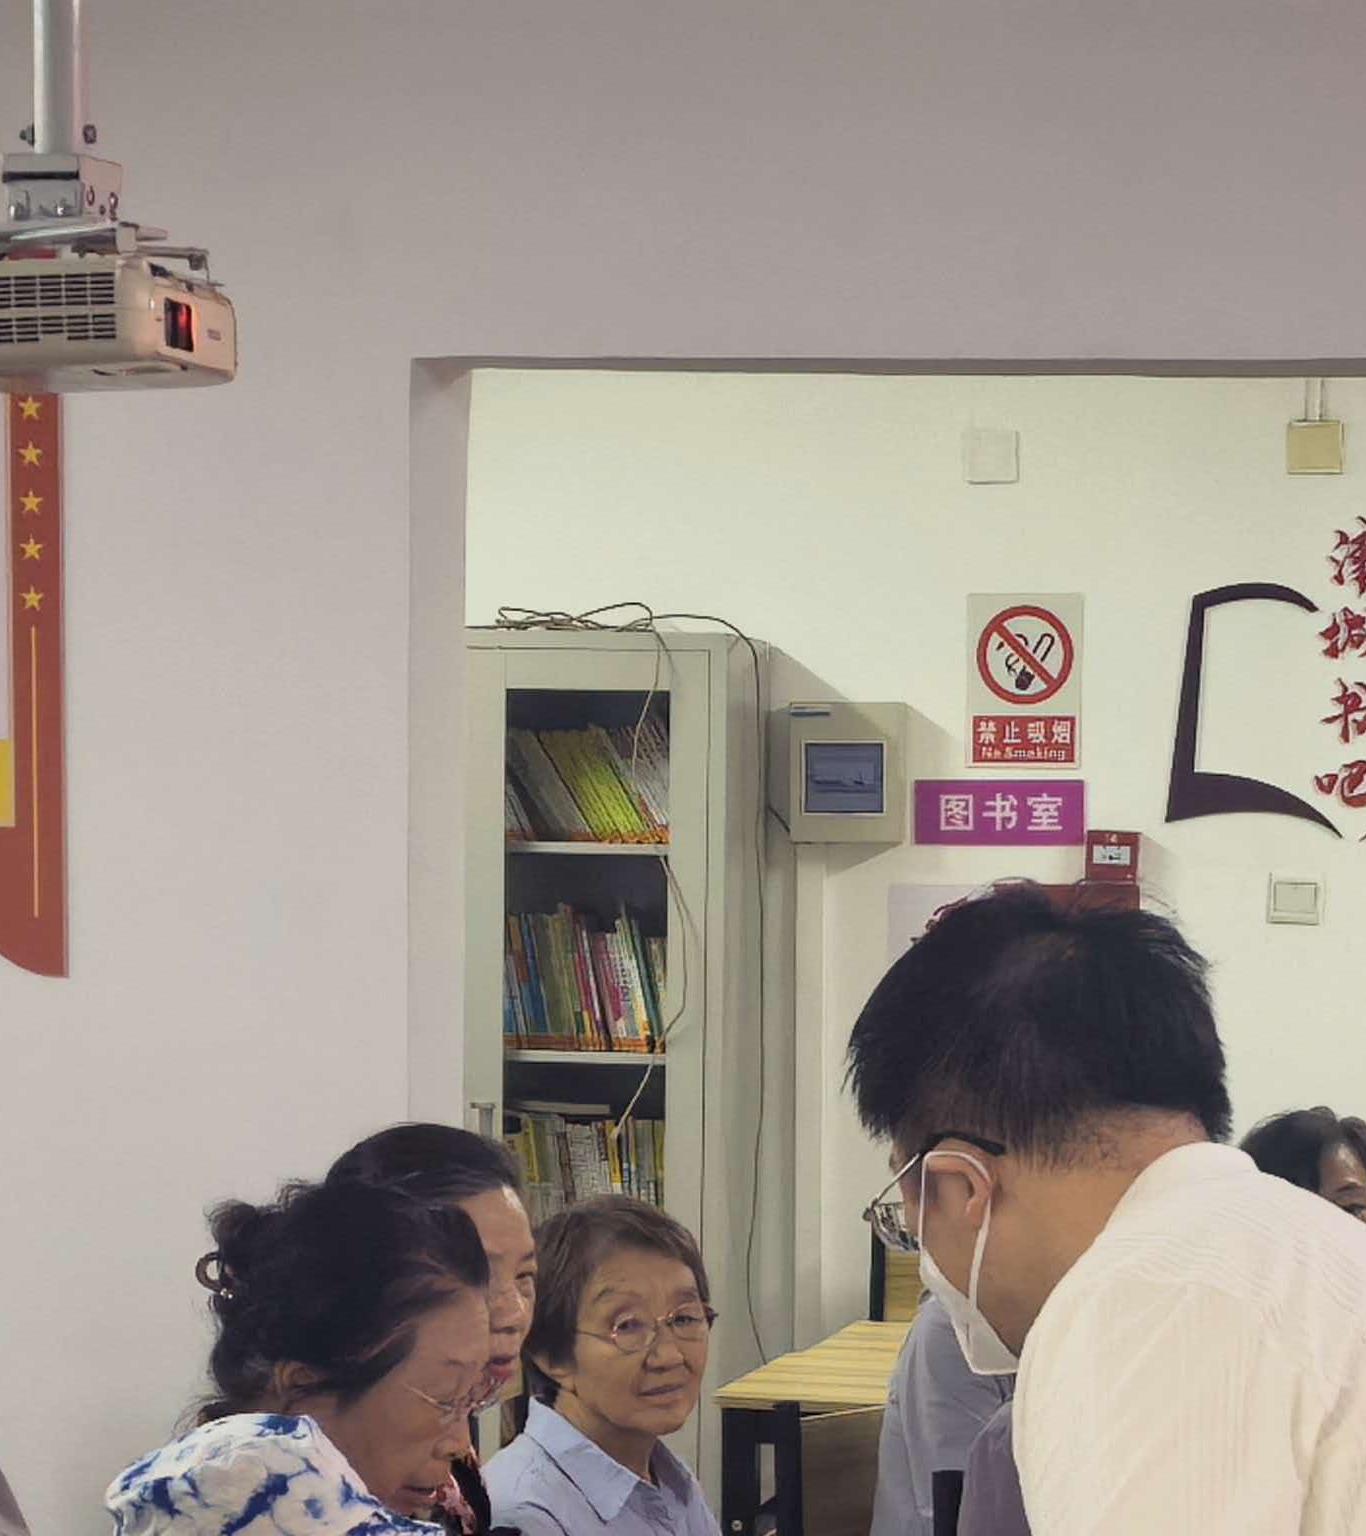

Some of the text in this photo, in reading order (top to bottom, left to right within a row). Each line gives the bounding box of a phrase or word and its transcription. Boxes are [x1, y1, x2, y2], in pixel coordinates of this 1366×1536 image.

[977, 719, 1072, 745] 禁止吸烟
[1004, 746, 1067, 762] Smoking
[939, 792, 1064, 832] 图书室
